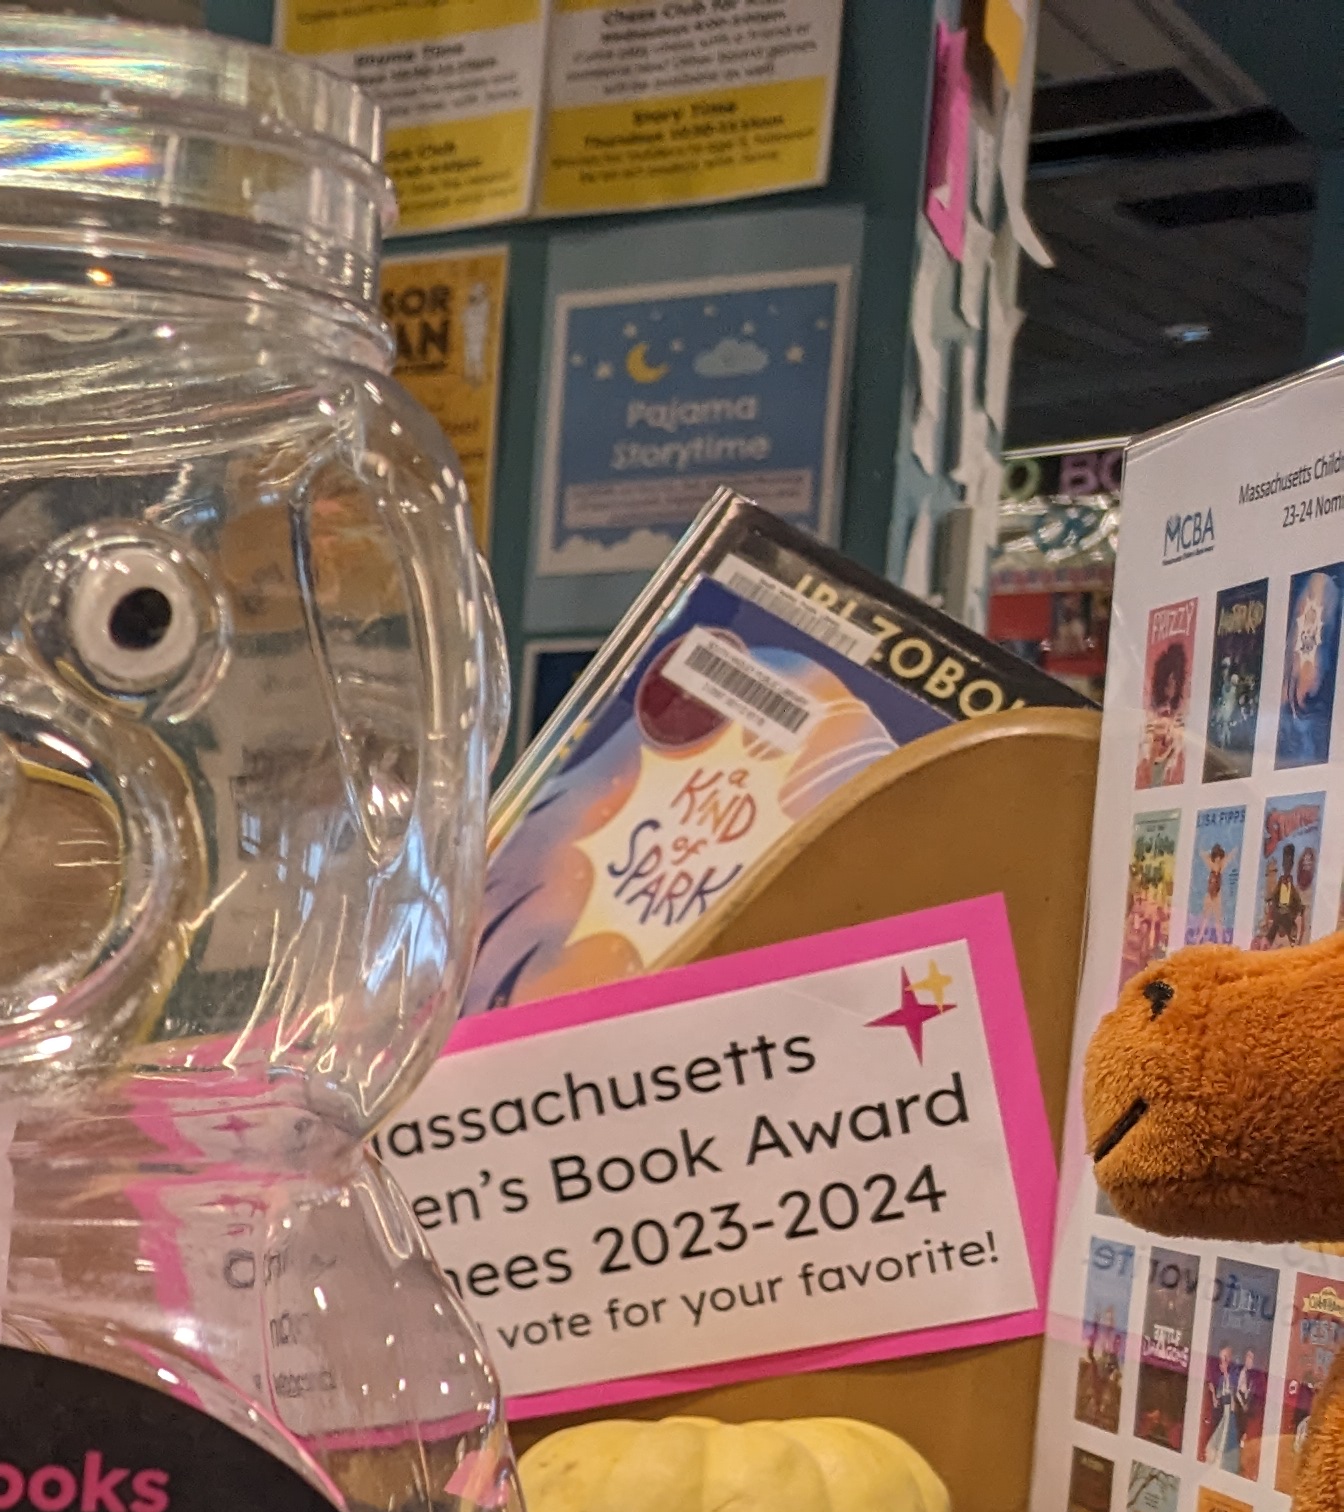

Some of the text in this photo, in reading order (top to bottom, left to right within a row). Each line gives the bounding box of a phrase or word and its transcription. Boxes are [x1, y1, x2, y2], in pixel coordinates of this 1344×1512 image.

[611, 435, 771, 472] Storytime
[626, 395, 758, 433] Pajama
[1238, 450, 1344, 505] Massachusetts Child
[1315, 495, 1344, 519] Nom
[1163, 507, 1215, 556] MCBA
[872, 616, 1027, 721] ZOBO
[372, 1033, 816, 1160] assachusetts
[551, 1128, 722, 1205] Book
[745, 1072, 970, 1167] Award
[592, 1162, 948, 1277] 2023-2024
[498, 1231, 1000, 1350] vote for your favorite!
